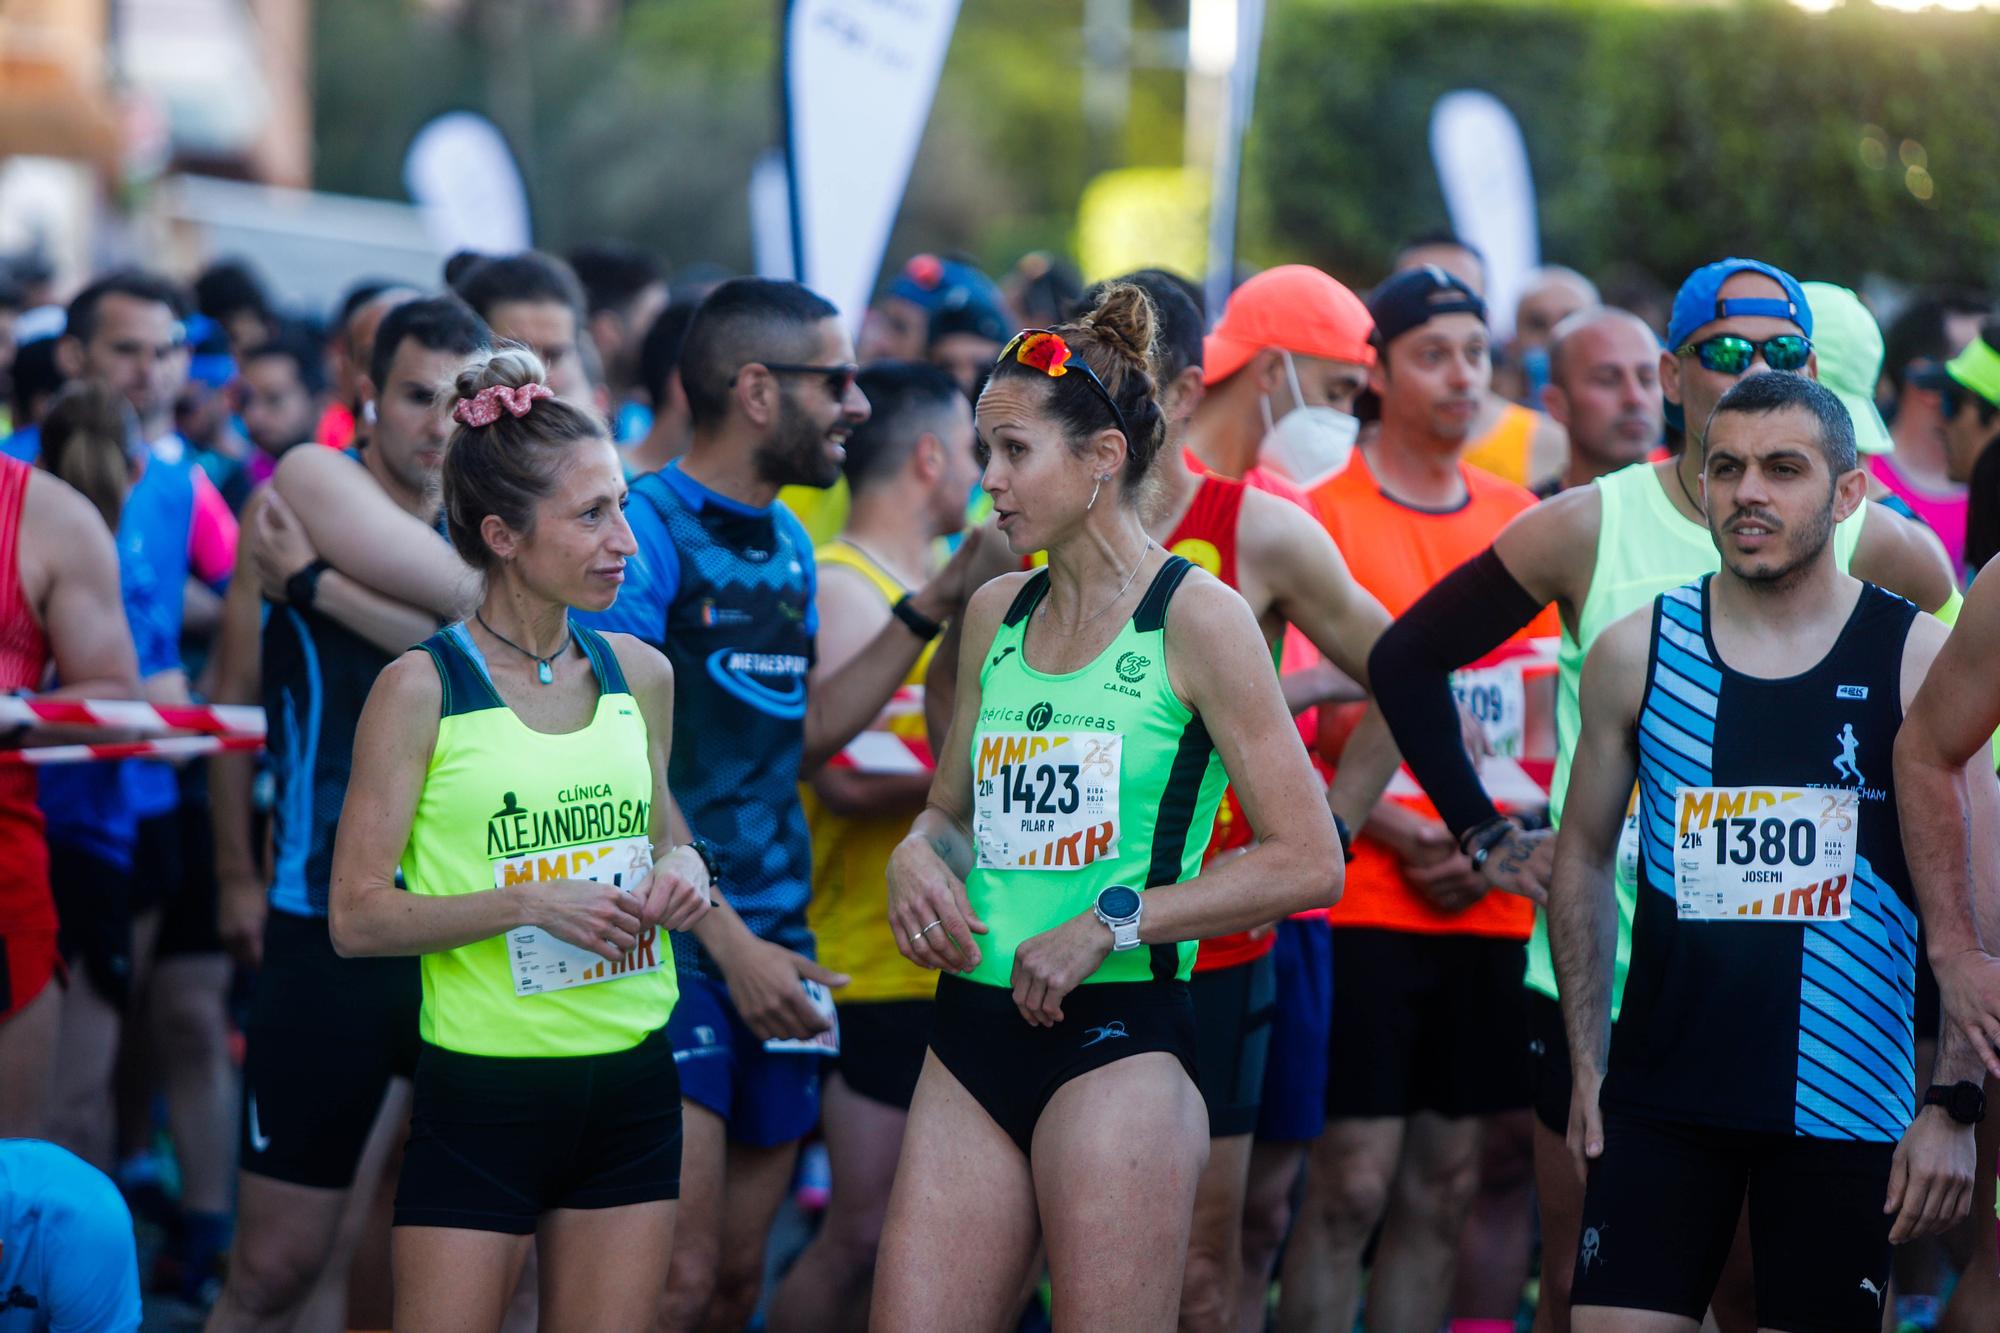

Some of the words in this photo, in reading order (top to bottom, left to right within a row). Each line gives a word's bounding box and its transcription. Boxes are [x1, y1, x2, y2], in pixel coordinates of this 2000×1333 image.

[1053, 711, 1116, 732] correas
[558, 783, 613, 803] CLÍNICA
[1000, 764, 1080, 815] 1423
[487, 801, 616, 856] ALEJANDRO
[1021, 819, 1046, 832] PILAR
[1048, 820, 1055, 832] R
[1681, 832, 1703, 849] 21k
[1712, 817, 1817, 867] 1380
[1742, 870, 1783, 883] JOSEMI
